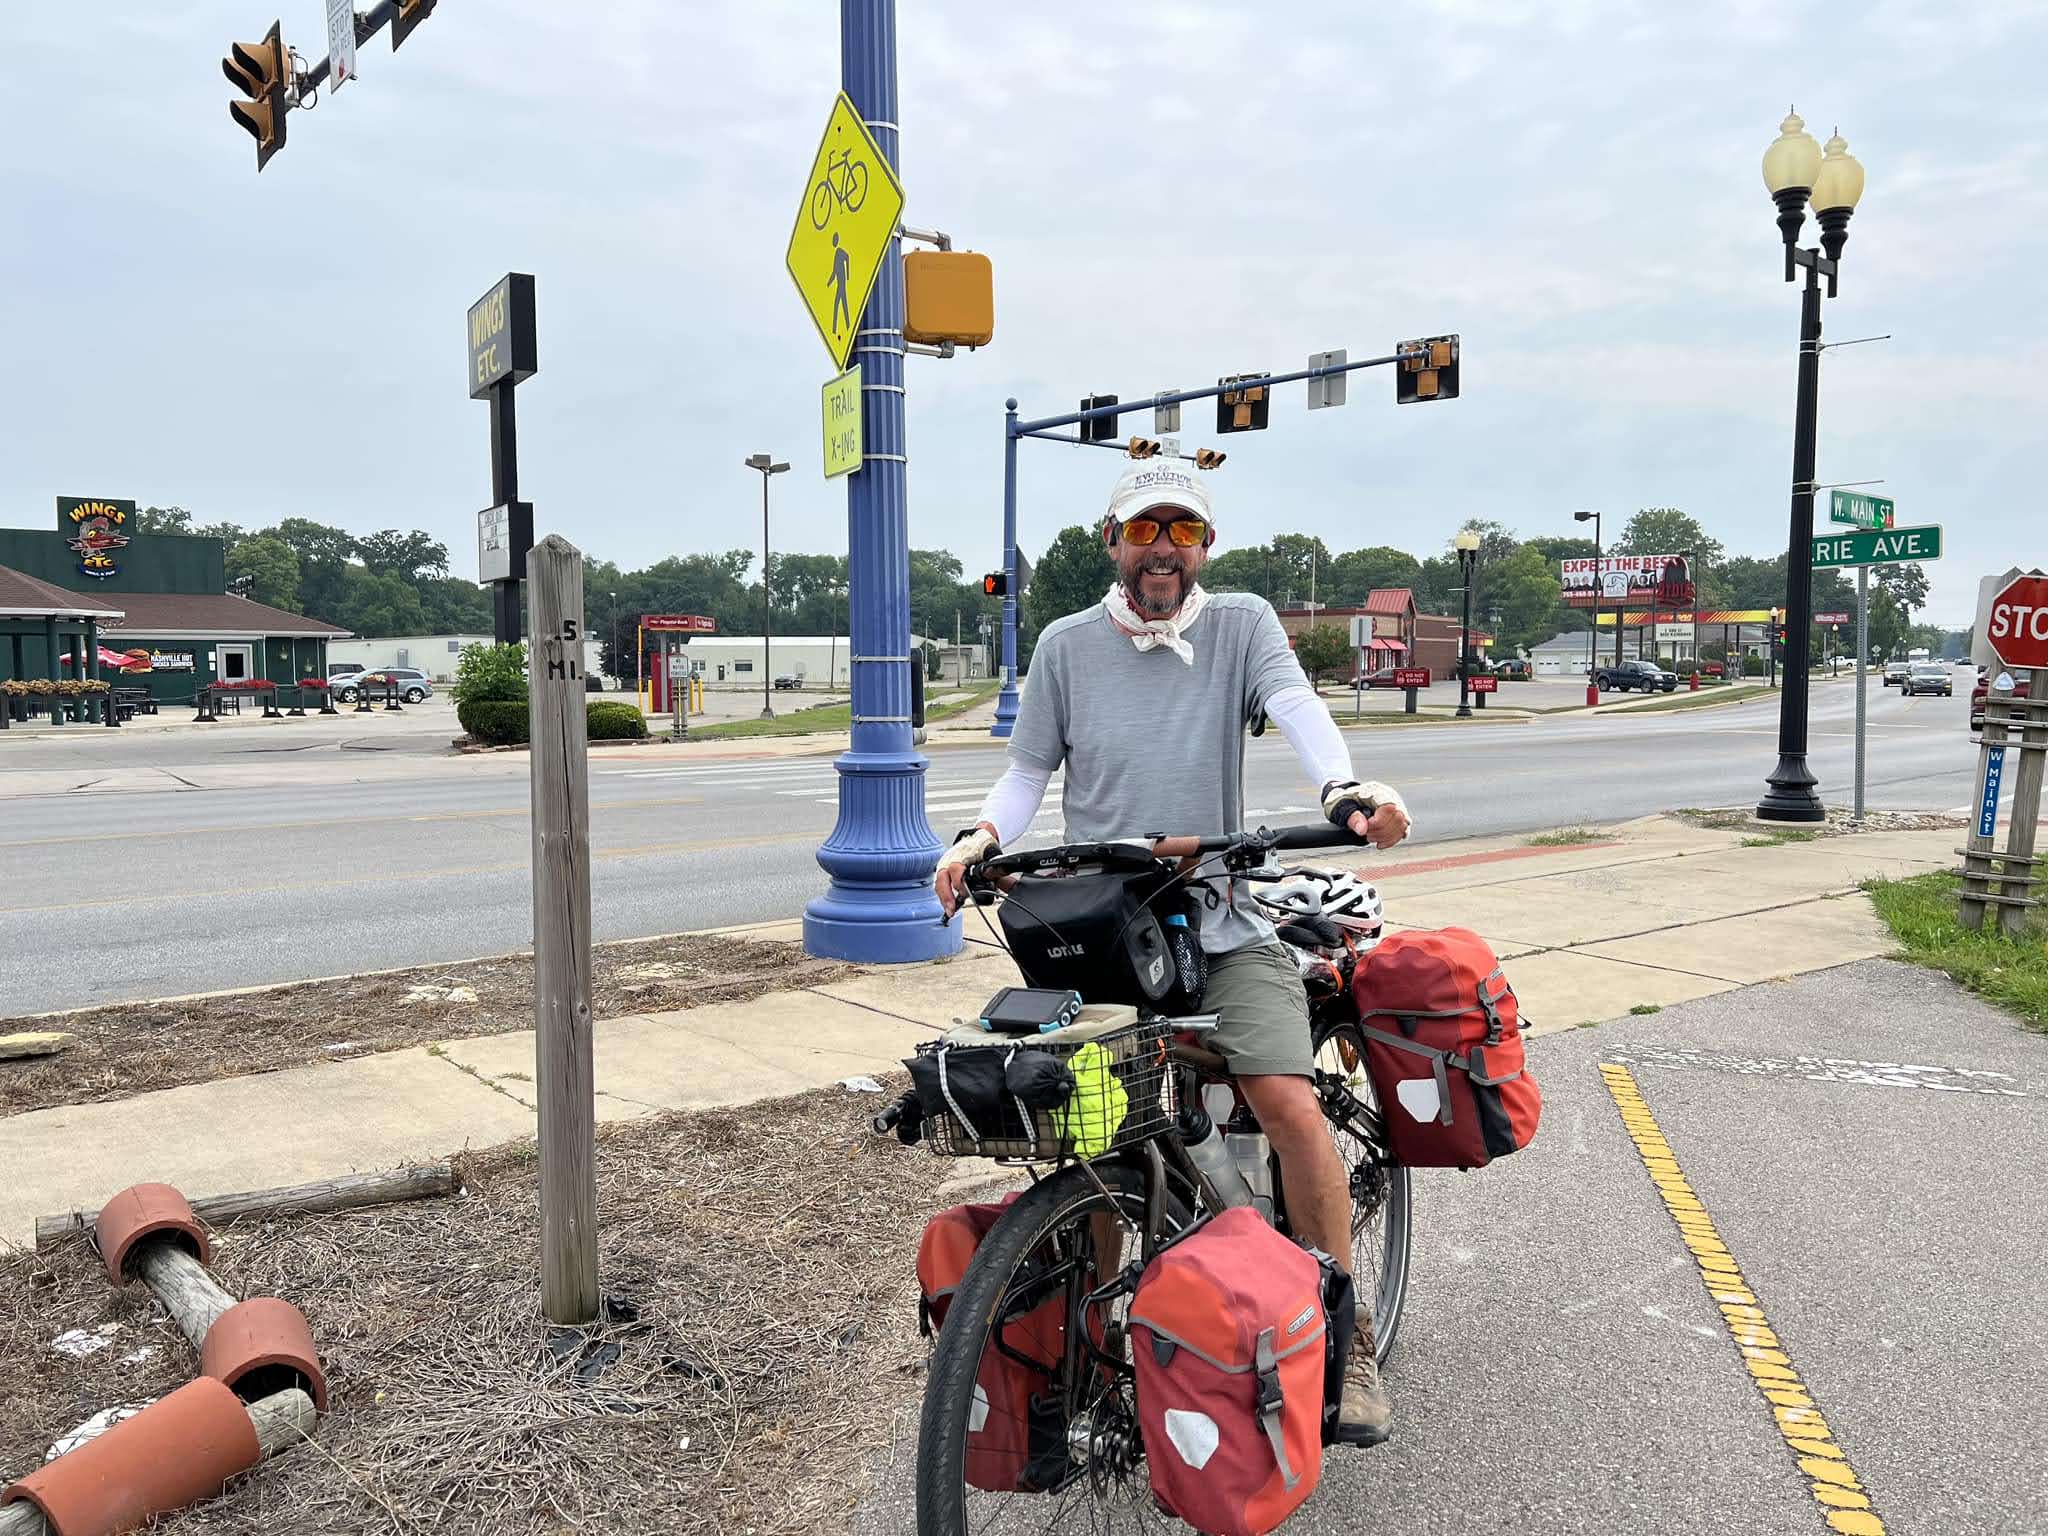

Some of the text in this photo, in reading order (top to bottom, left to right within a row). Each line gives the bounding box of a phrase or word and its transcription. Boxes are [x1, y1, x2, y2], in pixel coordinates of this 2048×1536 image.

[331, 8, 350, 41] STOP
[472, 288, 504, 352] WINGS
[478, 343, 500, 384] ETC.
[831, 388, 854, 420] TRAIL
[831, 428, 855, 462] X-ING
[69, 502, 126, 524] WINGS
[1834, 497, 1892, 524] W. MAIN ST.
[84, 556, 113, 568] ETC
[1811, 534, 1929, 562] RIE AVE.
[1563, 559, 1611, 573] EXPECT
[1615, 557, 1640, 571] THE
[548, 660, 583, 681] MI.
[1984, 751, 2003, 832] W Main St
